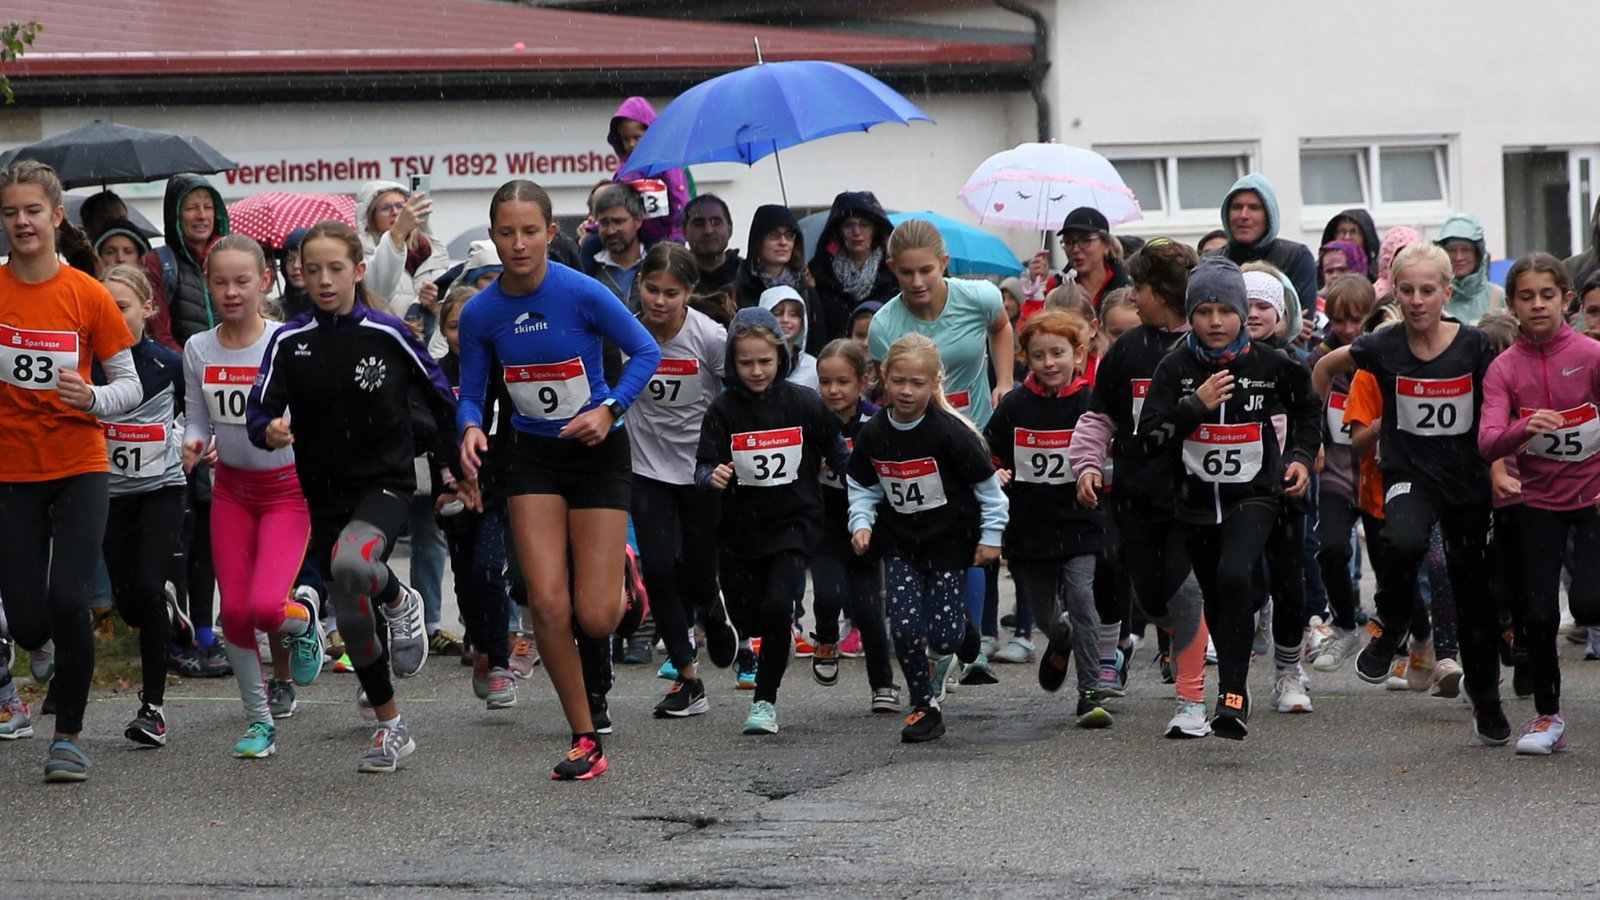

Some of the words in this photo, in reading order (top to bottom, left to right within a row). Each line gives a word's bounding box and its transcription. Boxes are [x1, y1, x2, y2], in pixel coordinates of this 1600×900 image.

[390, 155, 435, 179] TSV
[443, 153, 497, 176] 1892
[514, 321, 548, 335] skinfit
[24, 338, 61, 349] Sparkasse
[12, 354, 54, 384] 83
[533, 371, 567, 379] Sparkasse
[538, 386, 559, 414] 9
[649, 379, 682, 402] 97
[1426, 386, 1461, 396] Sparkasse
[1243, 394, 1265, 412] JR
[1416, 402, 1457, 429] 20
[118, 431, 150, 440] Sparkasse
[758, 436, 790, 448] Sparkasse
[1037, 438, 1069, 447] Sparkasse
[1212, 432, 1248, 442] Sparkasse
[1543, 431, 1583, 456] 25
[112, 446, 142, 472] 61
[752, 452, 787, 481] 32
[1031, 453, 1065, 479] 92
[1202, 449, 1242, 477] 65
[891, 468, 921, 477] Sparkasse
[890, 482, 925, 507] 54
